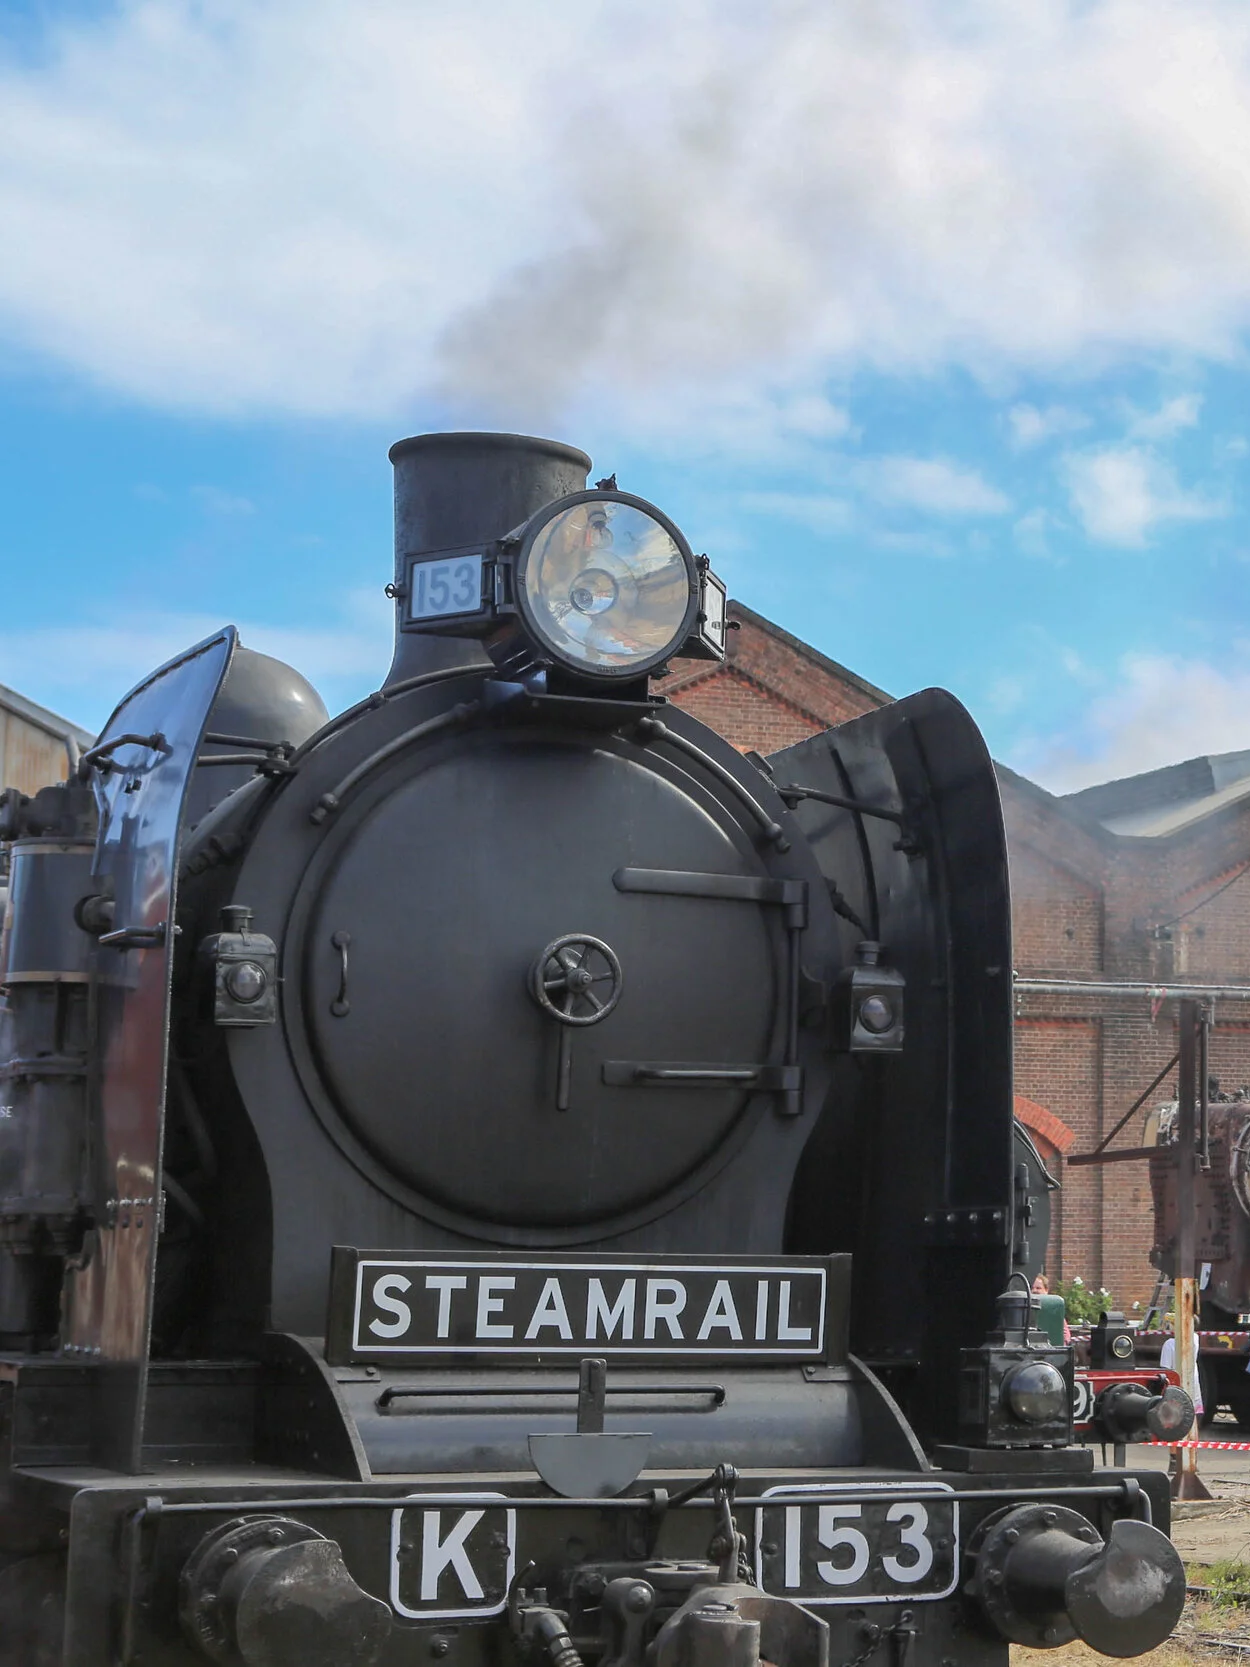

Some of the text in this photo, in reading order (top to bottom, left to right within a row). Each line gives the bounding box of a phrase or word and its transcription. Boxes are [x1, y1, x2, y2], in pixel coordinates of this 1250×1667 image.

[417, 562, 477, 613] 153
[367, 1272, 813, 1341] STEAMRAIL
[420, 1509, 486, 1601] K
[784, 1501, 934, 1589] 153
